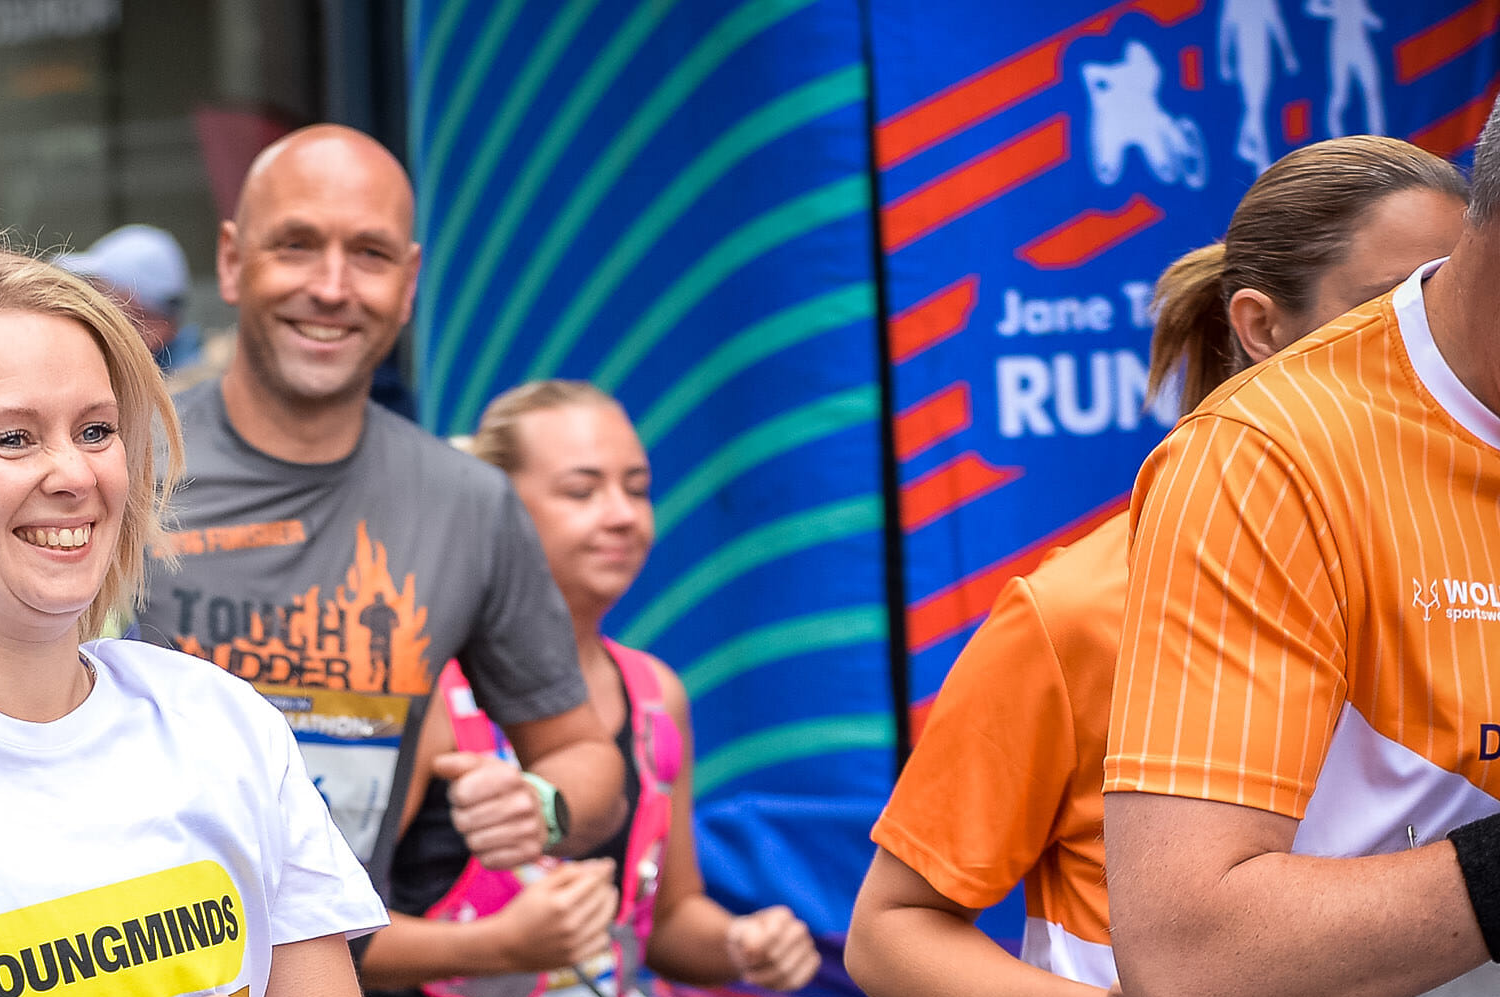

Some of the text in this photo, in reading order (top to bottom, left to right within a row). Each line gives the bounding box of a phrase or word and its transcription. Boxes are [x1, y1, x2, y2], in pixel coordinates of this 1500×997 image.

[997, 288, 1113, 336] Jane
[997, 352, 1183, 438] RUN
[172, 587, 347, 653] TOUGH
[190, 643, 350, 688] DDER
